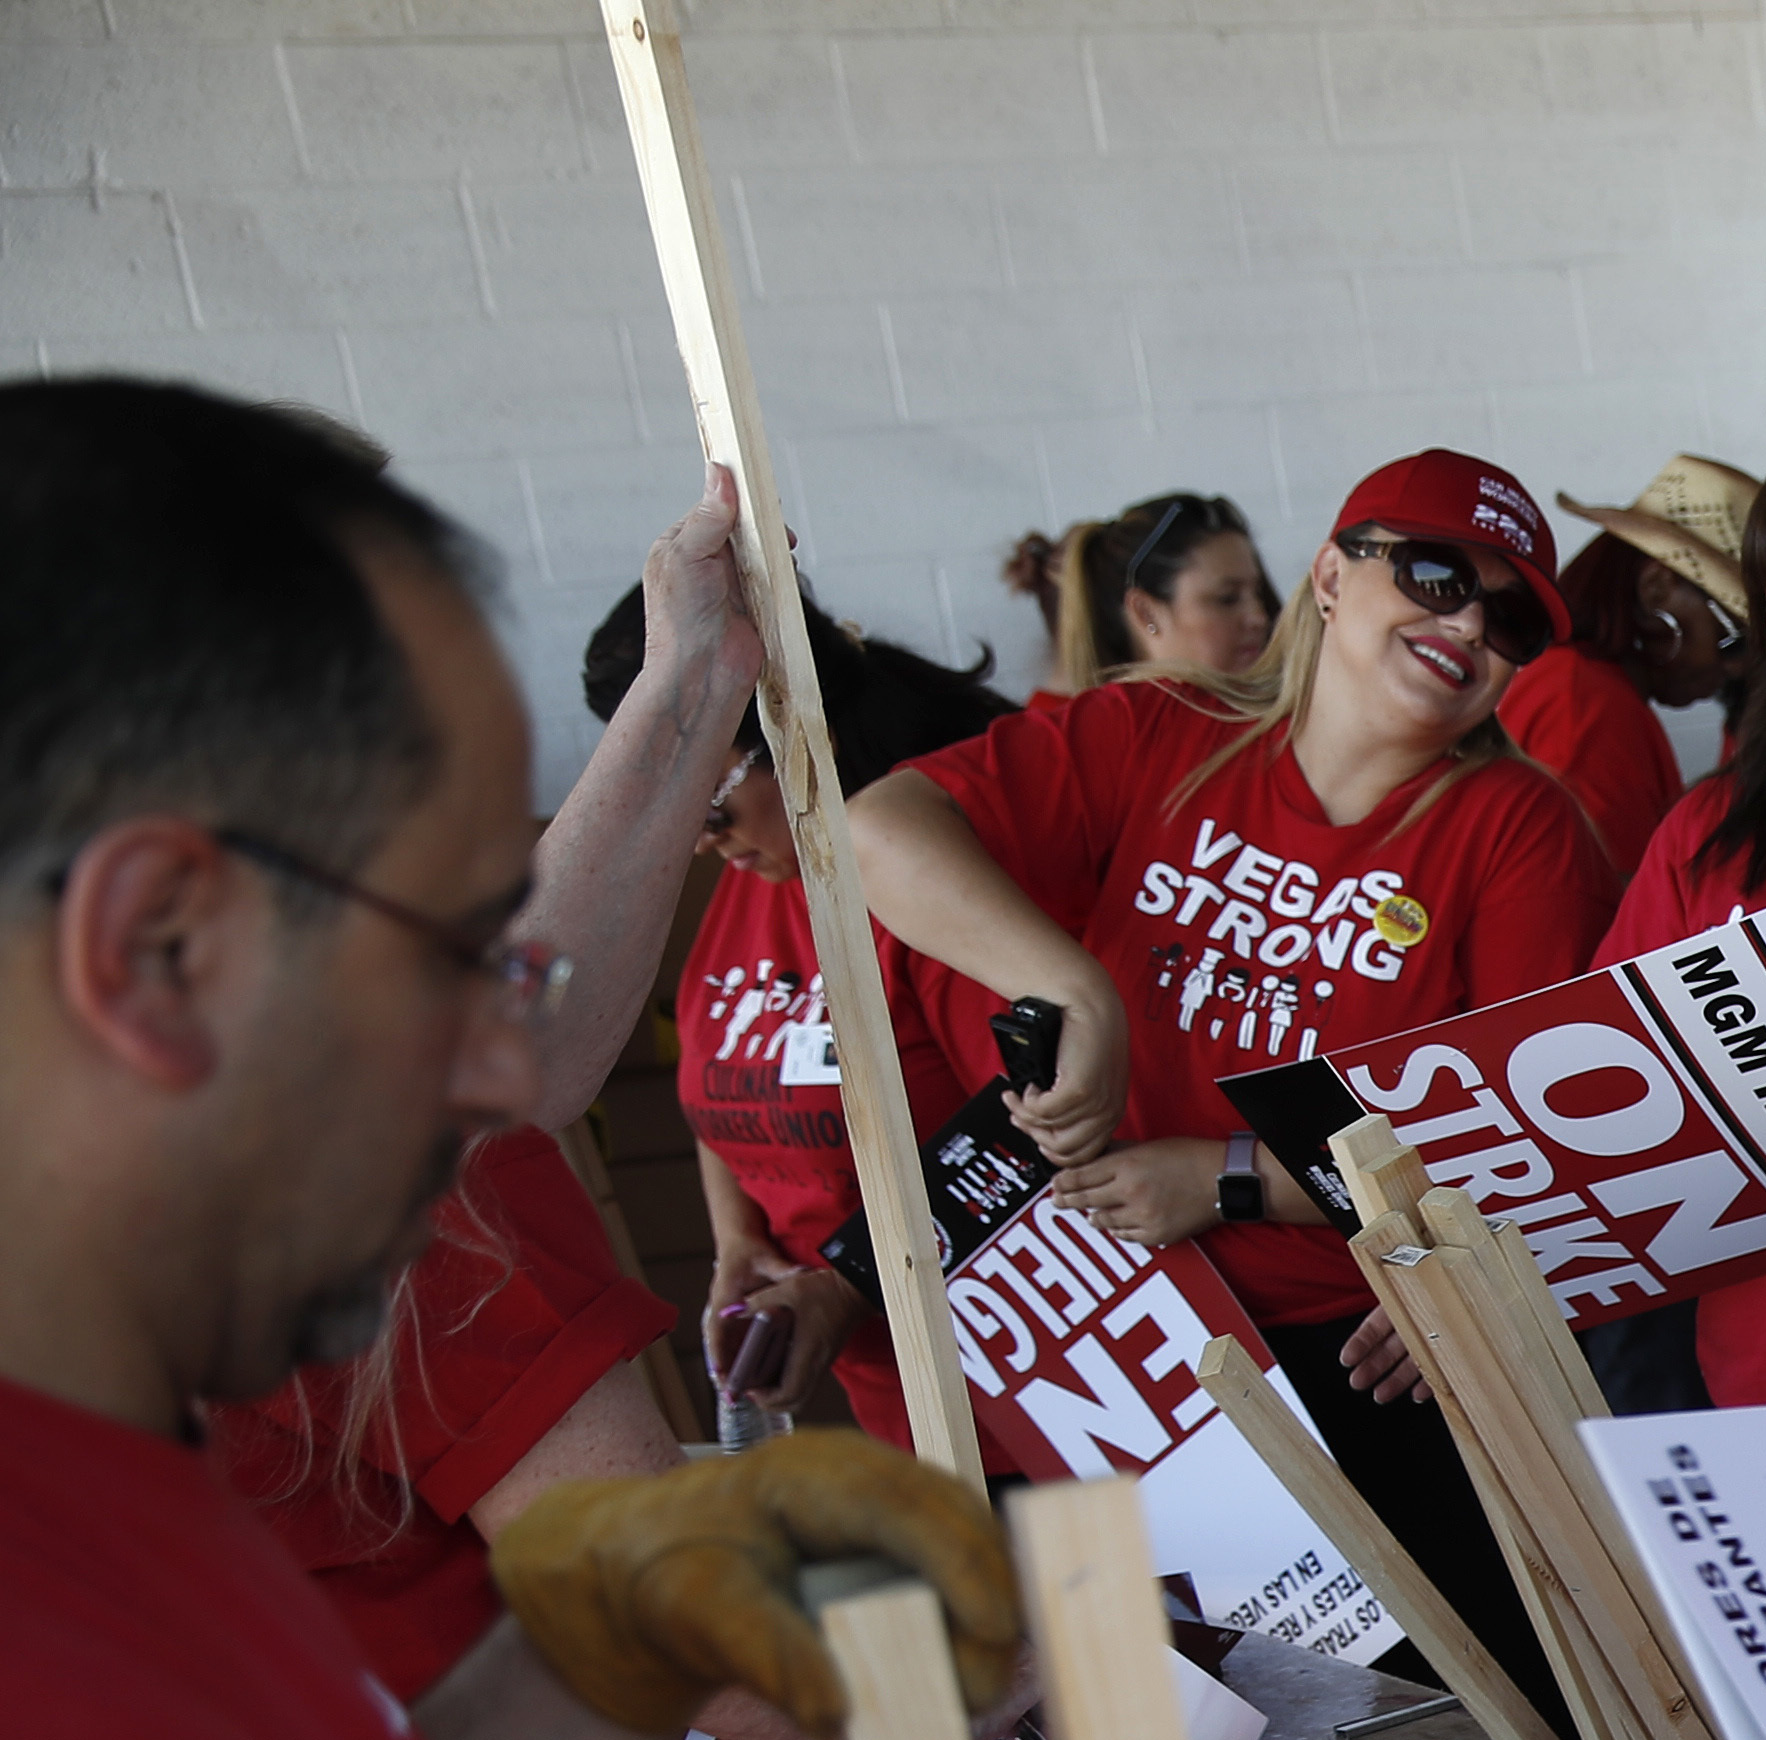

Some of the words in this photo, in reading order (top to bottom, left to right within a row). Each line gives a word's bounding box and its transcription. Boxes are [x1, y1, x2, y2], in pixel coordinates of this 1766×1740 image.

[1191, 818, 1404, 923] VEGAS
[1134, 861, 1407, 982] STRONG
[1346, 1044, 1668, 1320] STRIKE
[950, 1197, 1153, 1398] UELGA
[1646, 1475, 1706, 1544] DE
[1263, 1570, 1300, 1609] LAS
[1293, 1549, 1324, 1584] EN
[1300, 1604, 1318, 1629] Y
